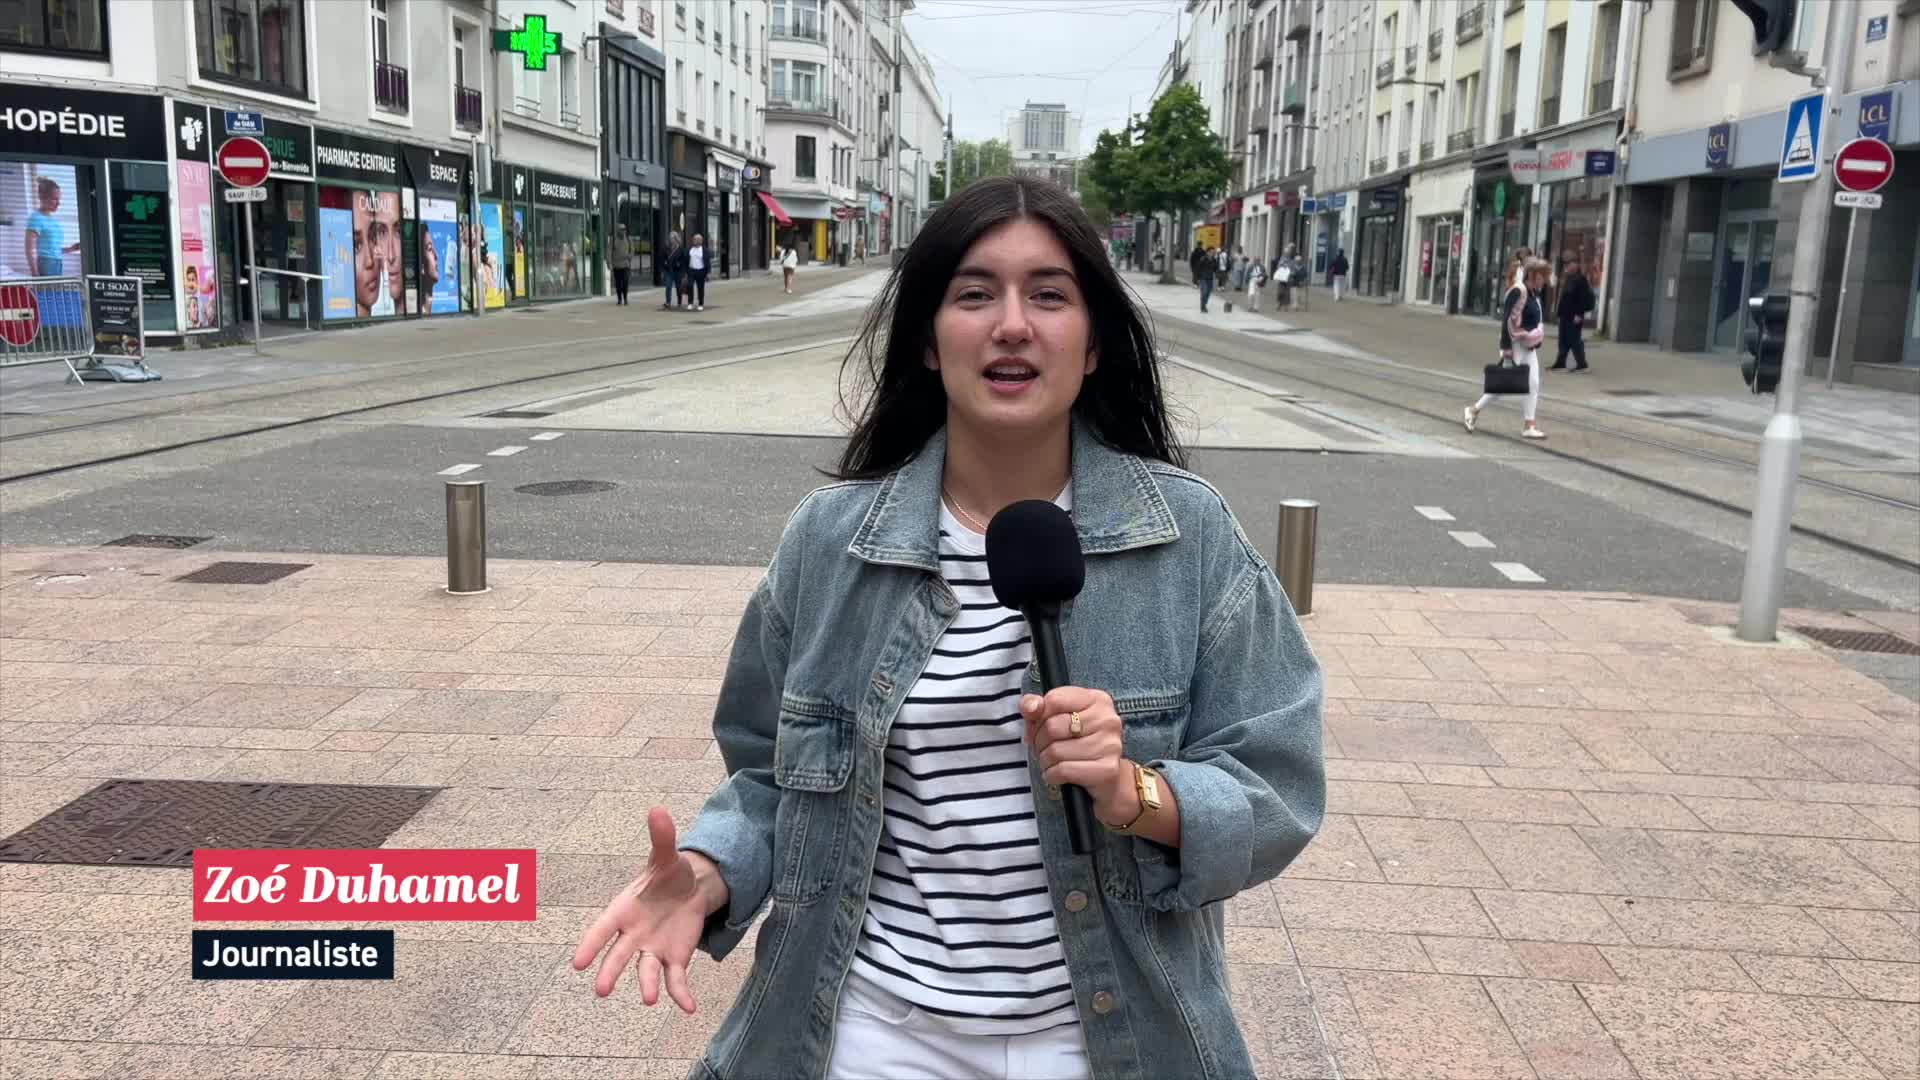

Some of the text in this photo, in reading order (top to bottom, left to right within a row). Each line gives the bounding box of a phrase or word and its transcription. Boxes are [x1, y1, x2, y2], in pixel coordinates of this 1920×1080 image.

[1860, 104, 1888, 124] LCL
[1709, 134, 1726, 149] LCL
[317, 146, 396, 174] PHARMACIE CENTRALE
[430, 164, 458, 183] ESPACE
[540, 182, 577, 200] ESPACE BEAUTÉ
[108, 282, 135, 292] SOAZ
